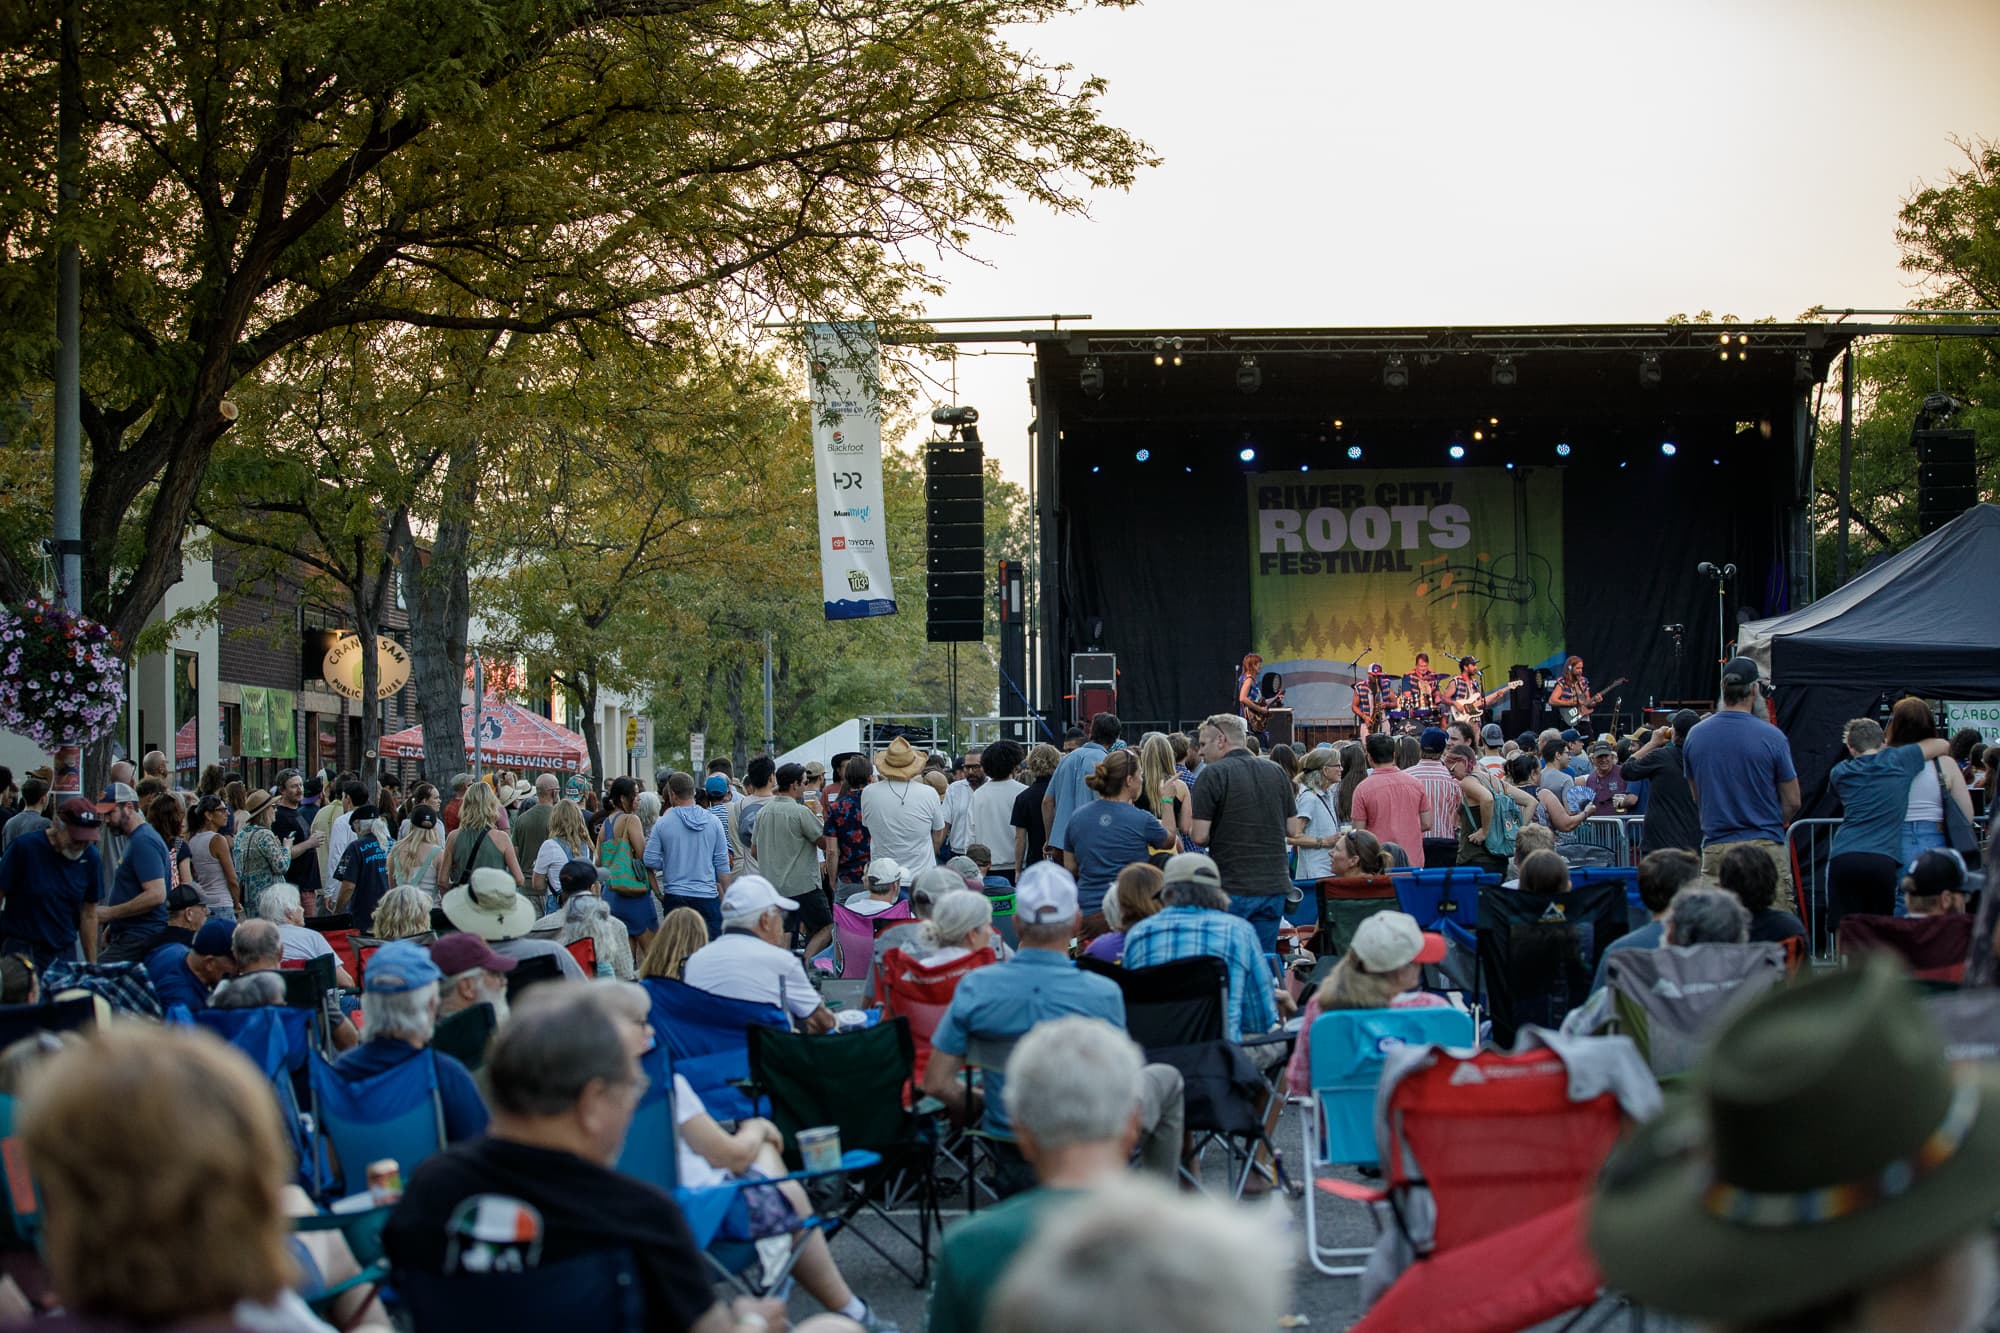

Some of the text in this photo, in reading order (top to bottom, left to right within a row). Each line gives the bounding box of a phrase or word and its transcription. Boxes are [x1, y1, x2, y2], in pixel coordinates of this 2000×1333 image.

[827, 443, 864, 452] Blackfoot
[832, 472, 863, 490] HDR
[1258, 481, 1454, 510] RIVER CITY
[1258, 504, 1471, 554] ROOTS
[1260, 550, 1413, 576] FESTIVAL
[329, 638, 405, 665] CRAN SAM
[332, 678, 403, 698] PUBLIC OUSE
[466, 751, 492, 763] AM
[496, 753, 563, 769] BREWING
